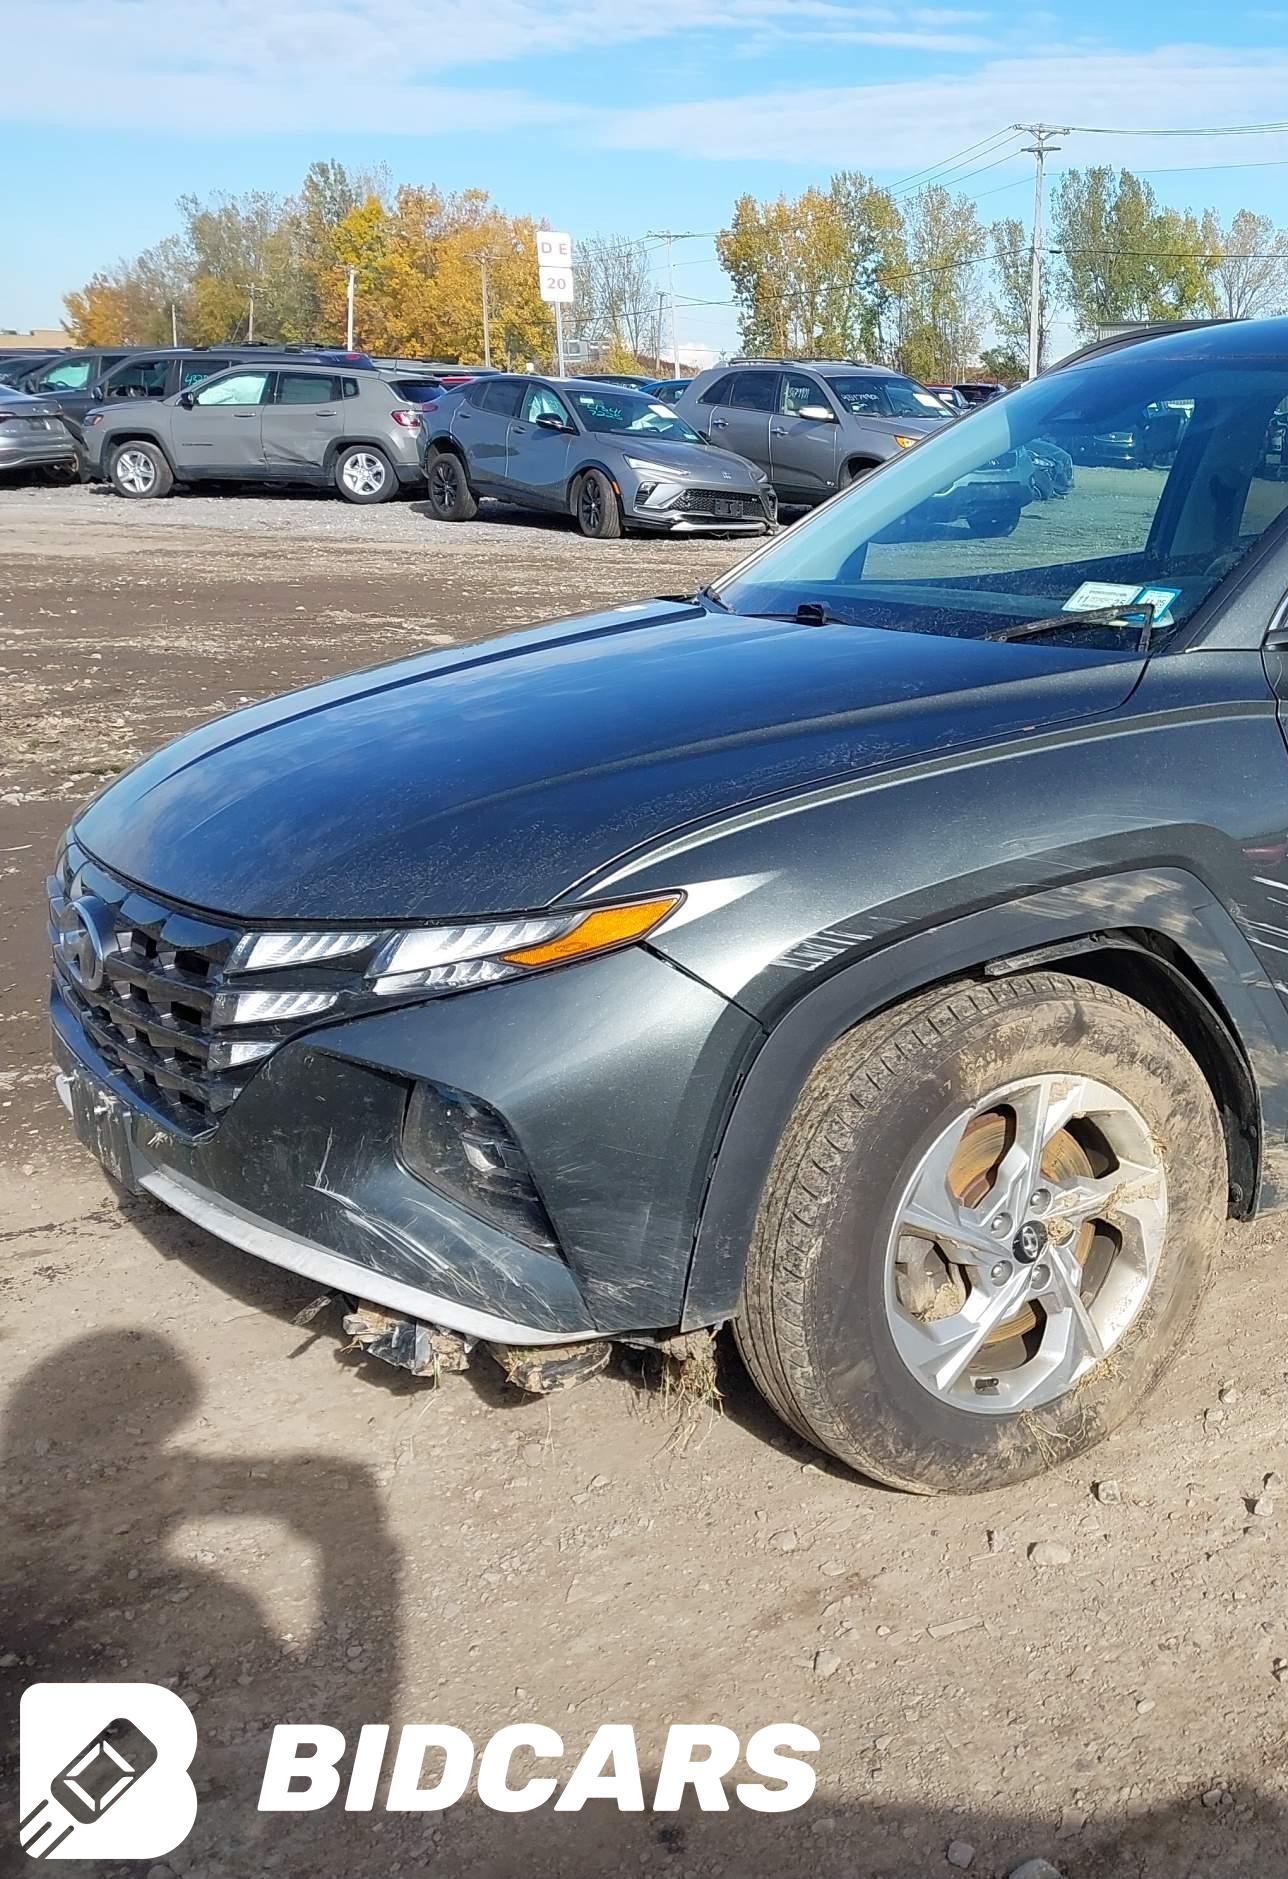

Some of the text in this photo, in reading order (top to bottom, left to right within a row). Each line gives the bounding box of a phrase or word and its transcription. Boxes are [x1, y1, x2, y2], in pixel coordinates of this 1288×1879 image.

[541, 242, 568, 255] D E
[547, 277, 566, 290] 20
